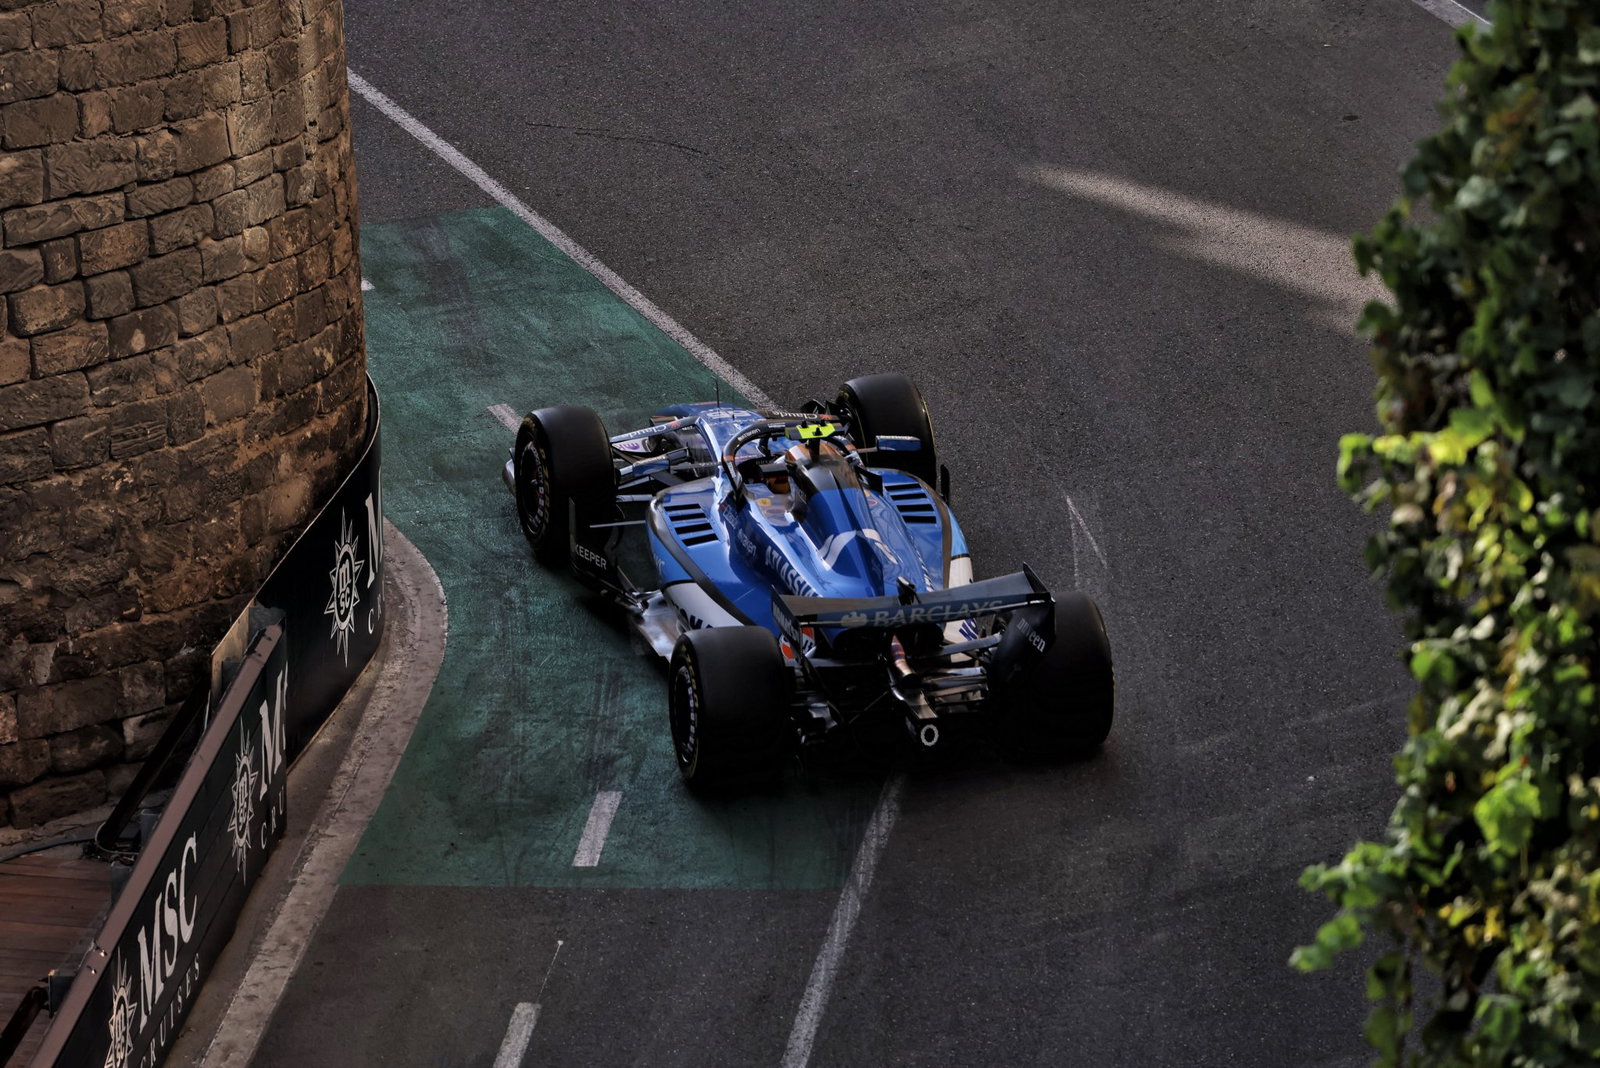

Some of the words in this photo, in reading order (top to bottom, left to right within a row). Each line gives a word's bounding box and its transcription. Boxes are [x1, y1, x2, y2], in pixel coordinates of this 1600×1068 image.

[873, 600, 1003, 627] BARCLAYS
[1016, 618, 1047, 653] nuveen
[260, 661, 288, 800] M
[137, 832, 198, 1034] MSC
